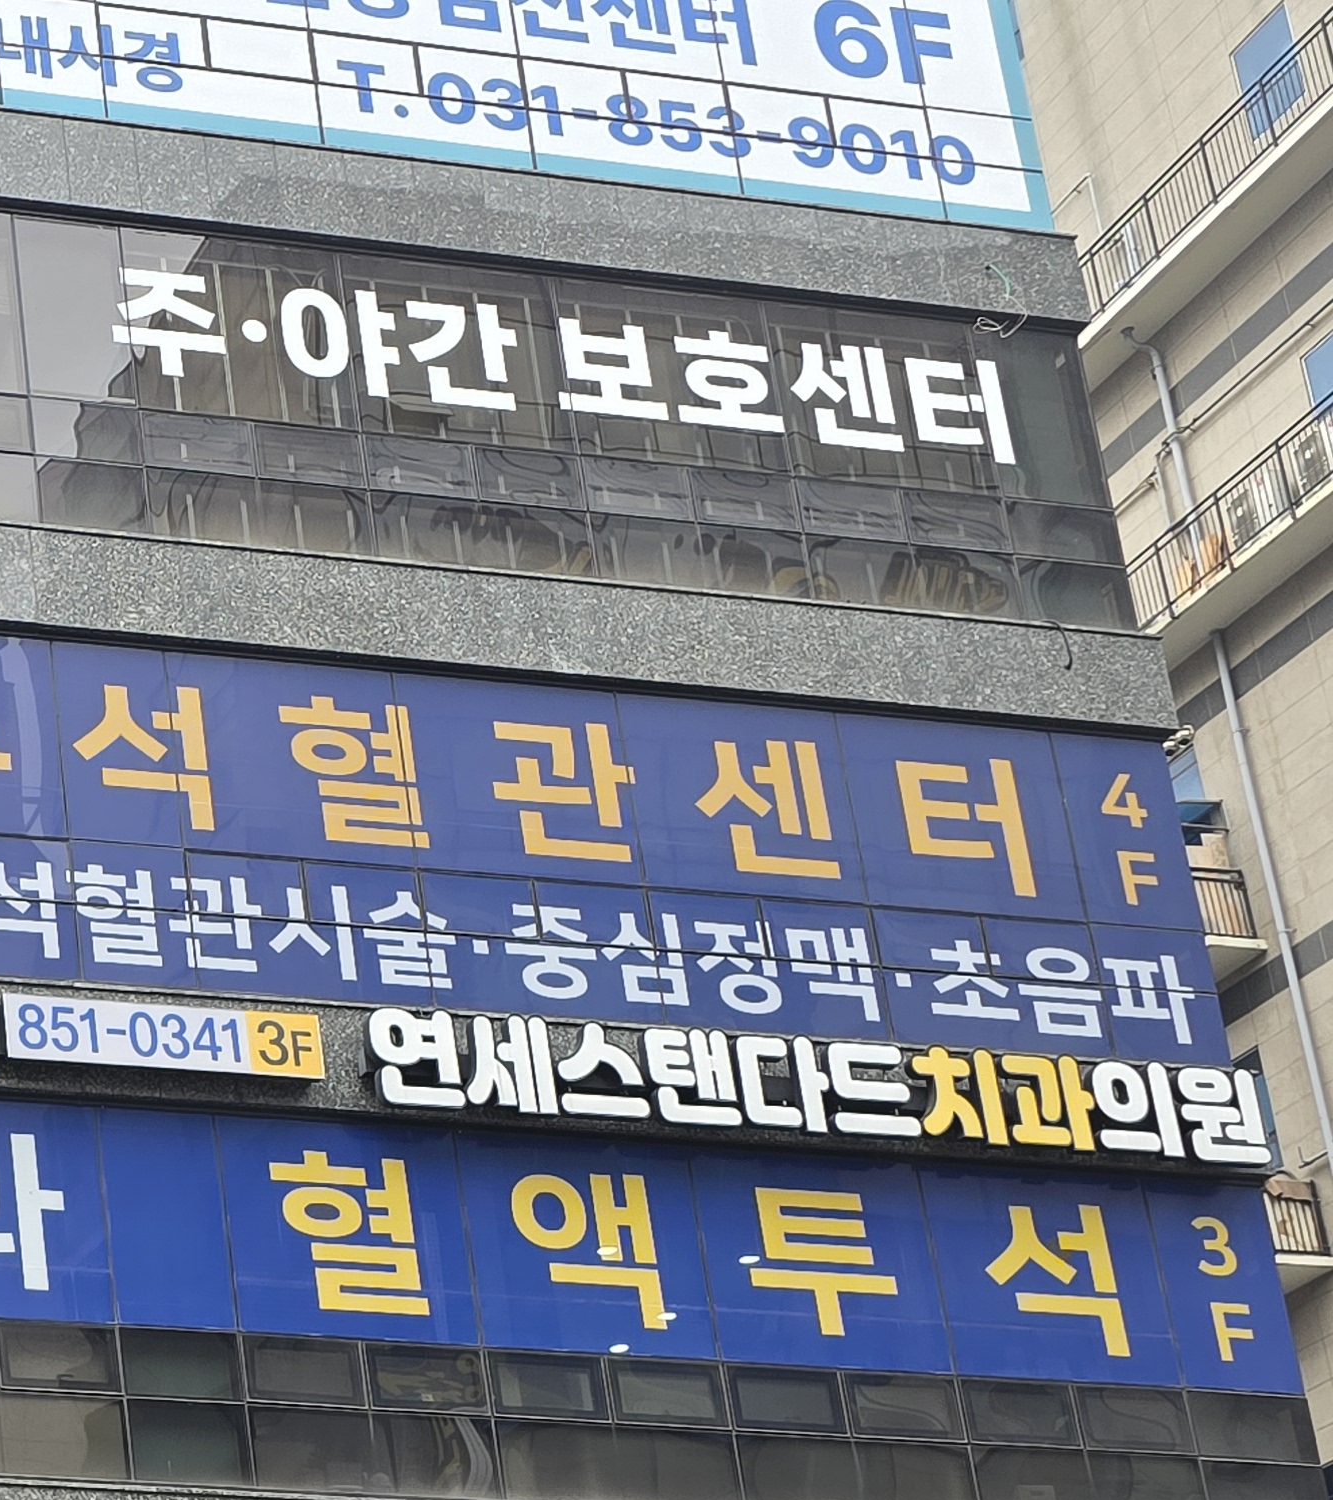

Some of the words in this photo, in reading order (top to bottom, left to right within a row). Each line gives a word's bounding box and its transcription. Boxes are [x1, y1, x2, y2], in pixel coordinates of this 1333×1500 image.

[814, 0, 953, 85] 6F
[558, 317, 1017, 465] 보호센터
[17, 1003, 244, 1064] 851-0341
[257, 1015, 314, 1068] 3F
[369, 1008, 1274, 1166] 연세스탠다드치과의원
